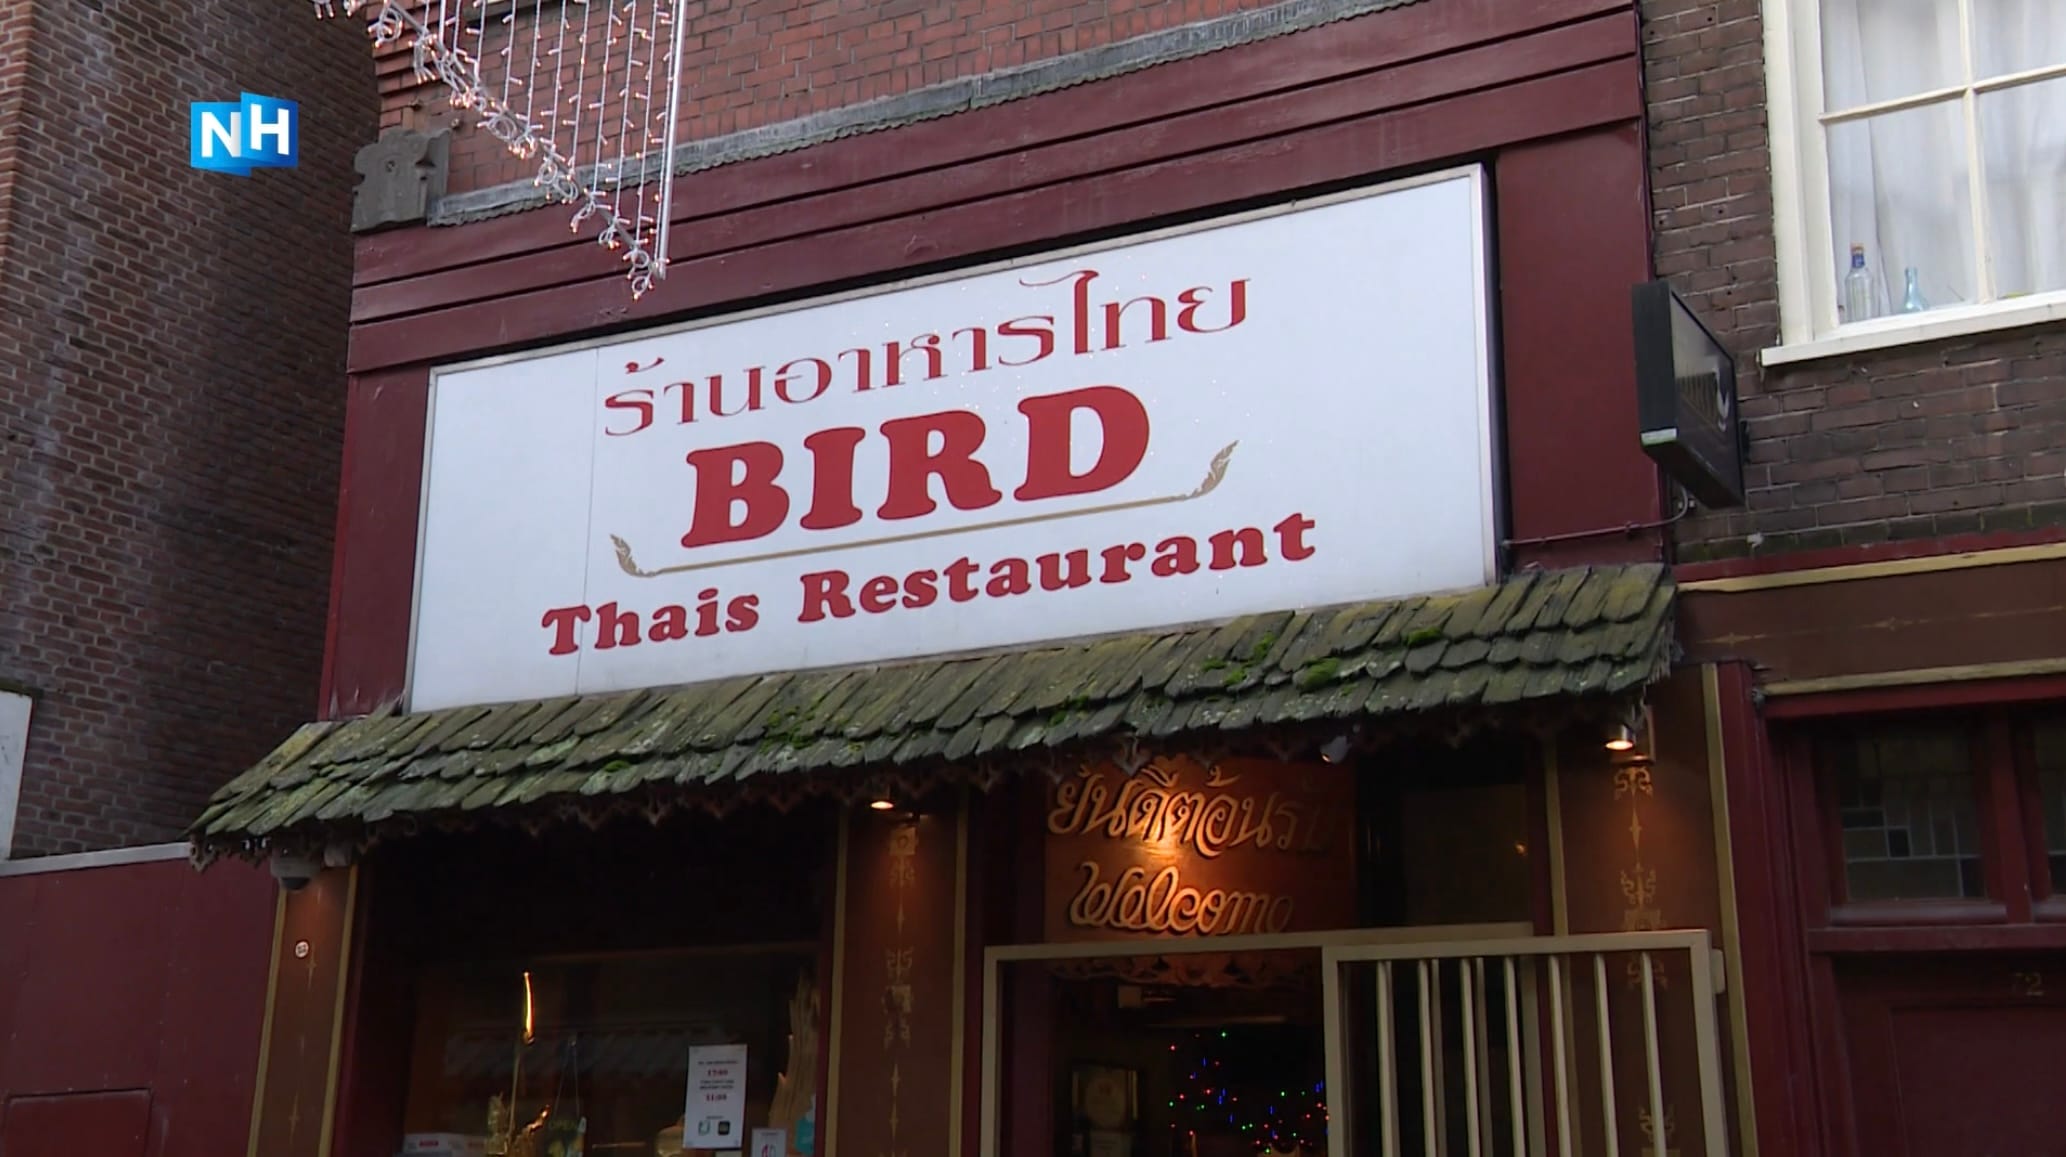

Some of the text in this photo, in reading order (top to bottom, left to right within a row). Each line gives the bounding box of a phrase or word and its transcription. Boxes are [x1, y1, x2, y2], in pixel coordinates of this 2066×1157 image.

[604, 269, 1250, 436] ร้านอาหารไทย
[681, 384, 1151, 548] BIRD
[541, 513, 1316, 655] Thais Restaurant
